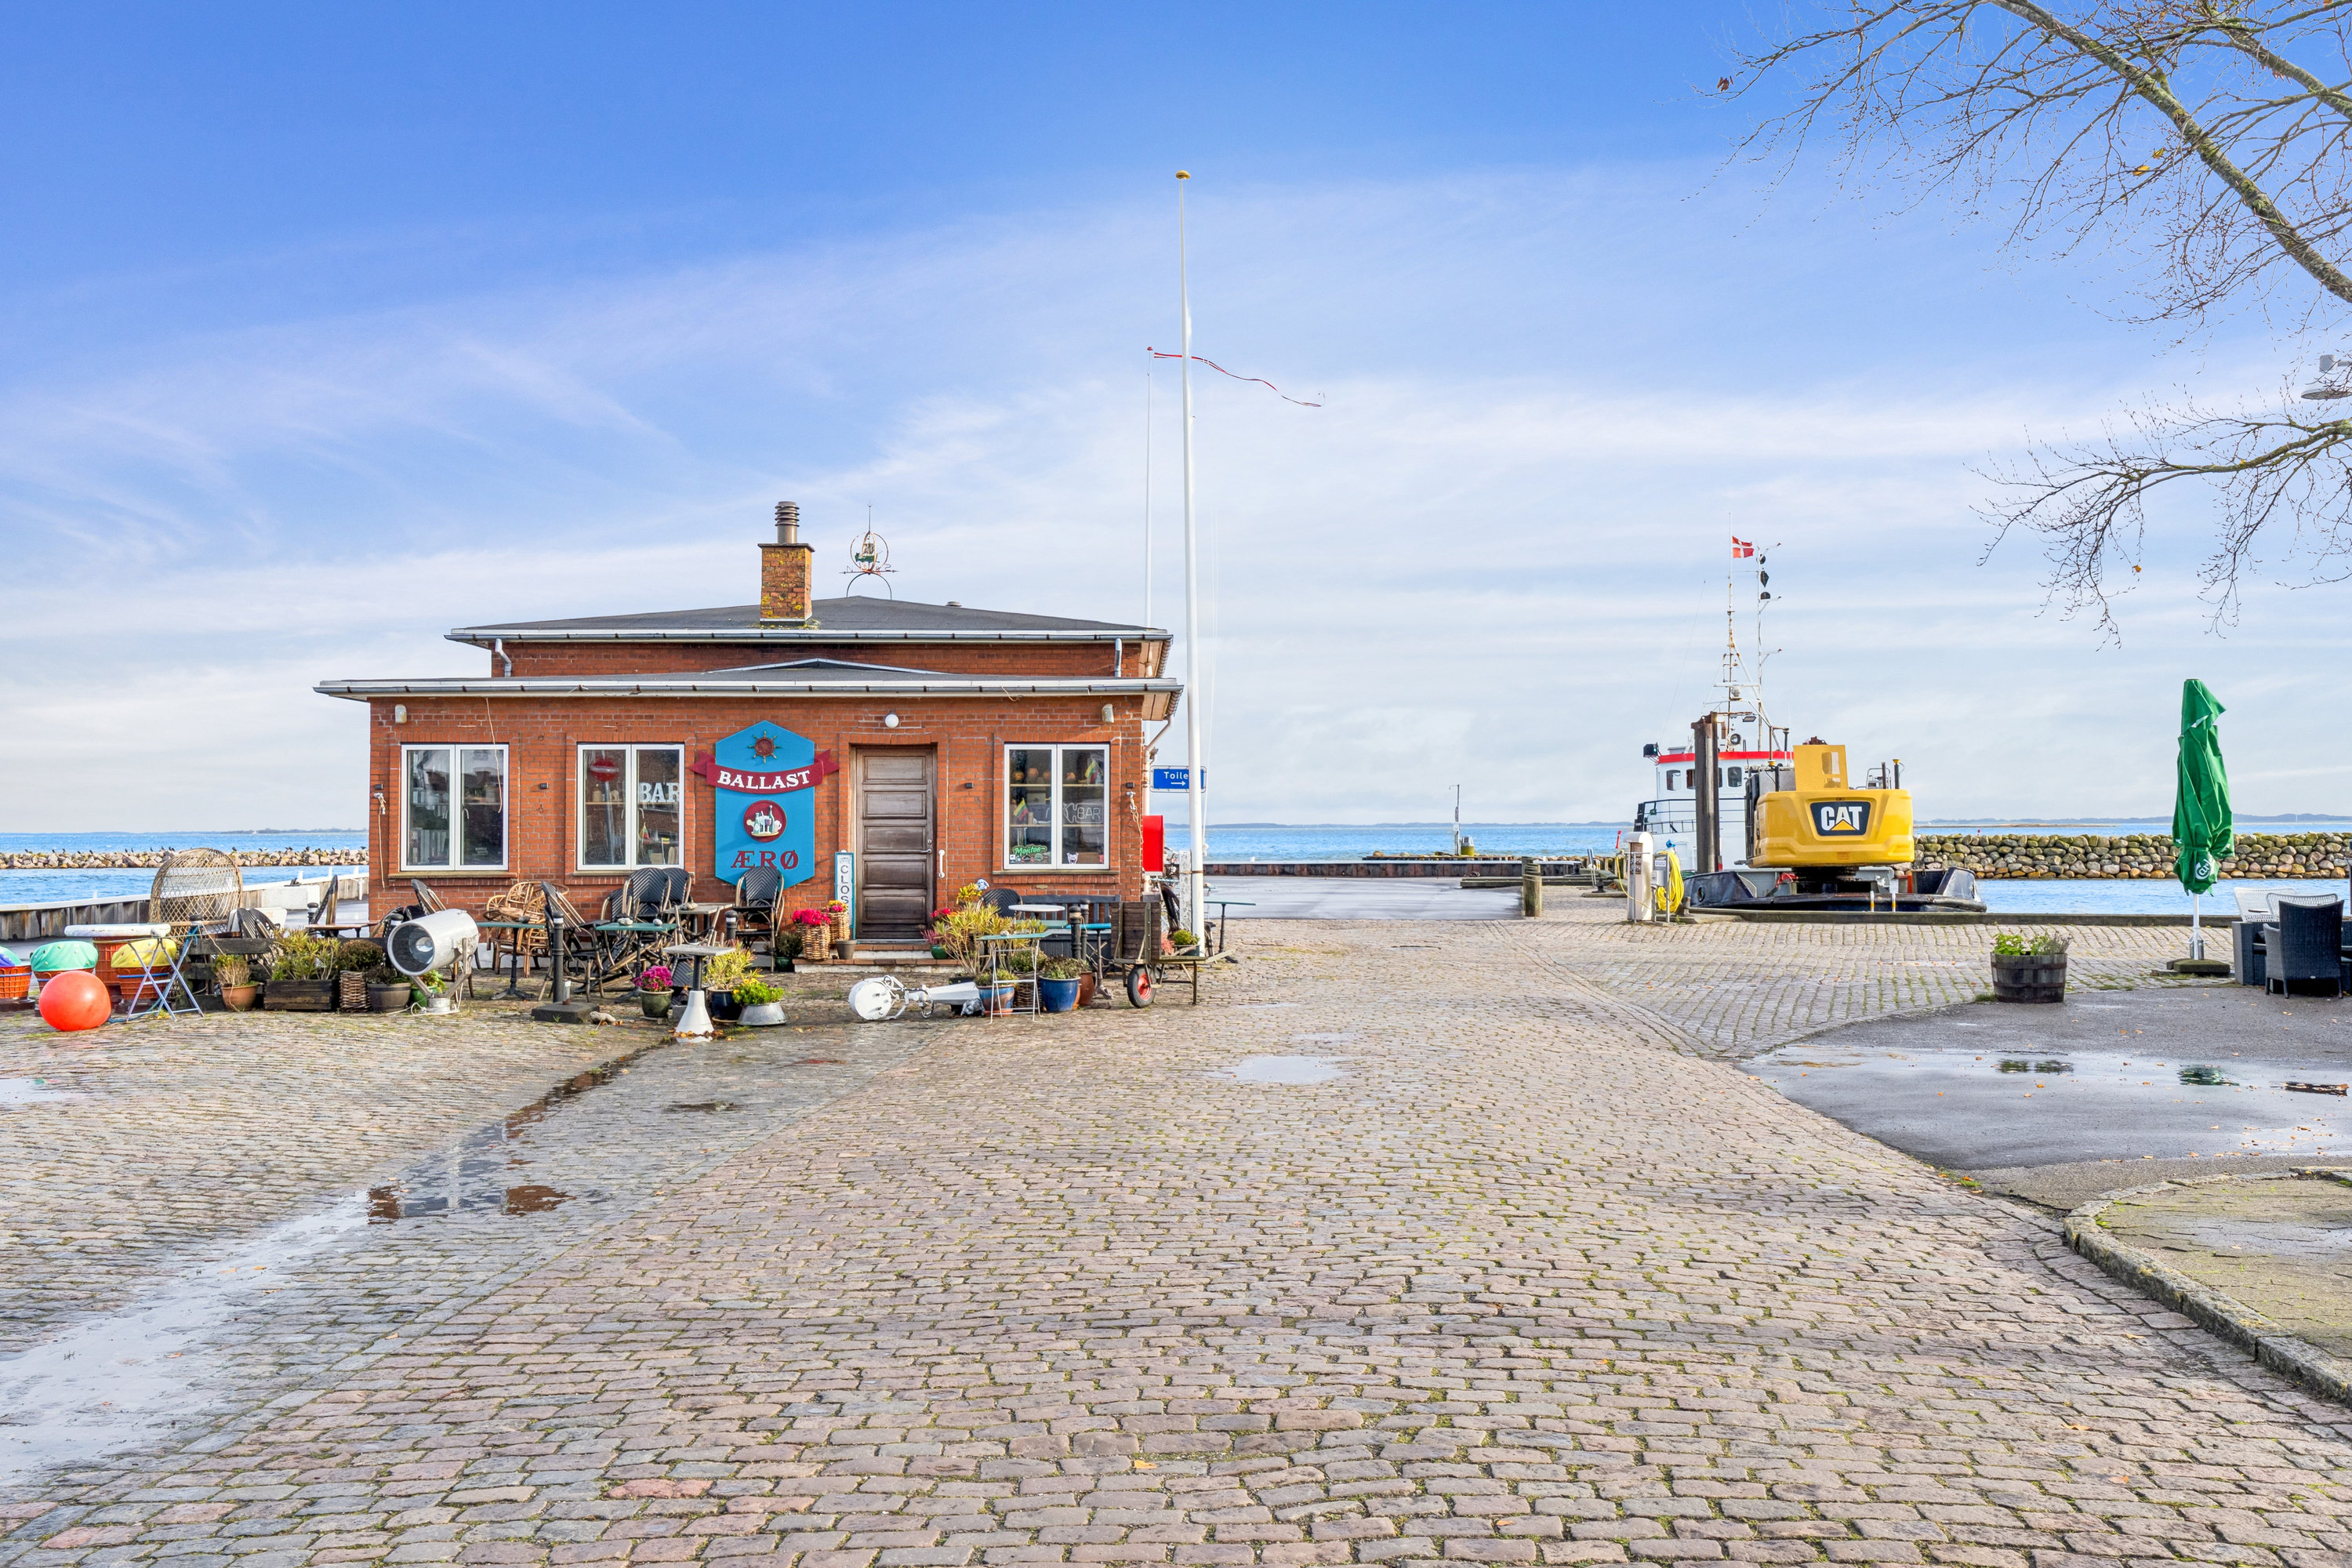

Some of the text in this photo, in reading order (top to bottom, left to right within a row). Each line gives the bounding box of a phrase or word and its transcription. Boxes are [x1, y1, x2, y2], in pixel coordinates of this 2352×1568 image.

[717, 771, 810, 789] BALLAST
[639, 782, 680, 803] BAR
[1077, 808, 1101, 819] BAR
[1820, 807, 1862, 830] CAT
[731, 850, 799, 869] ÆRØ
[1014, 846, 1046, 857] Mojitos
[2195, 858, 2212, 880] Carl
[840, 865, 849, 908] CLOS
